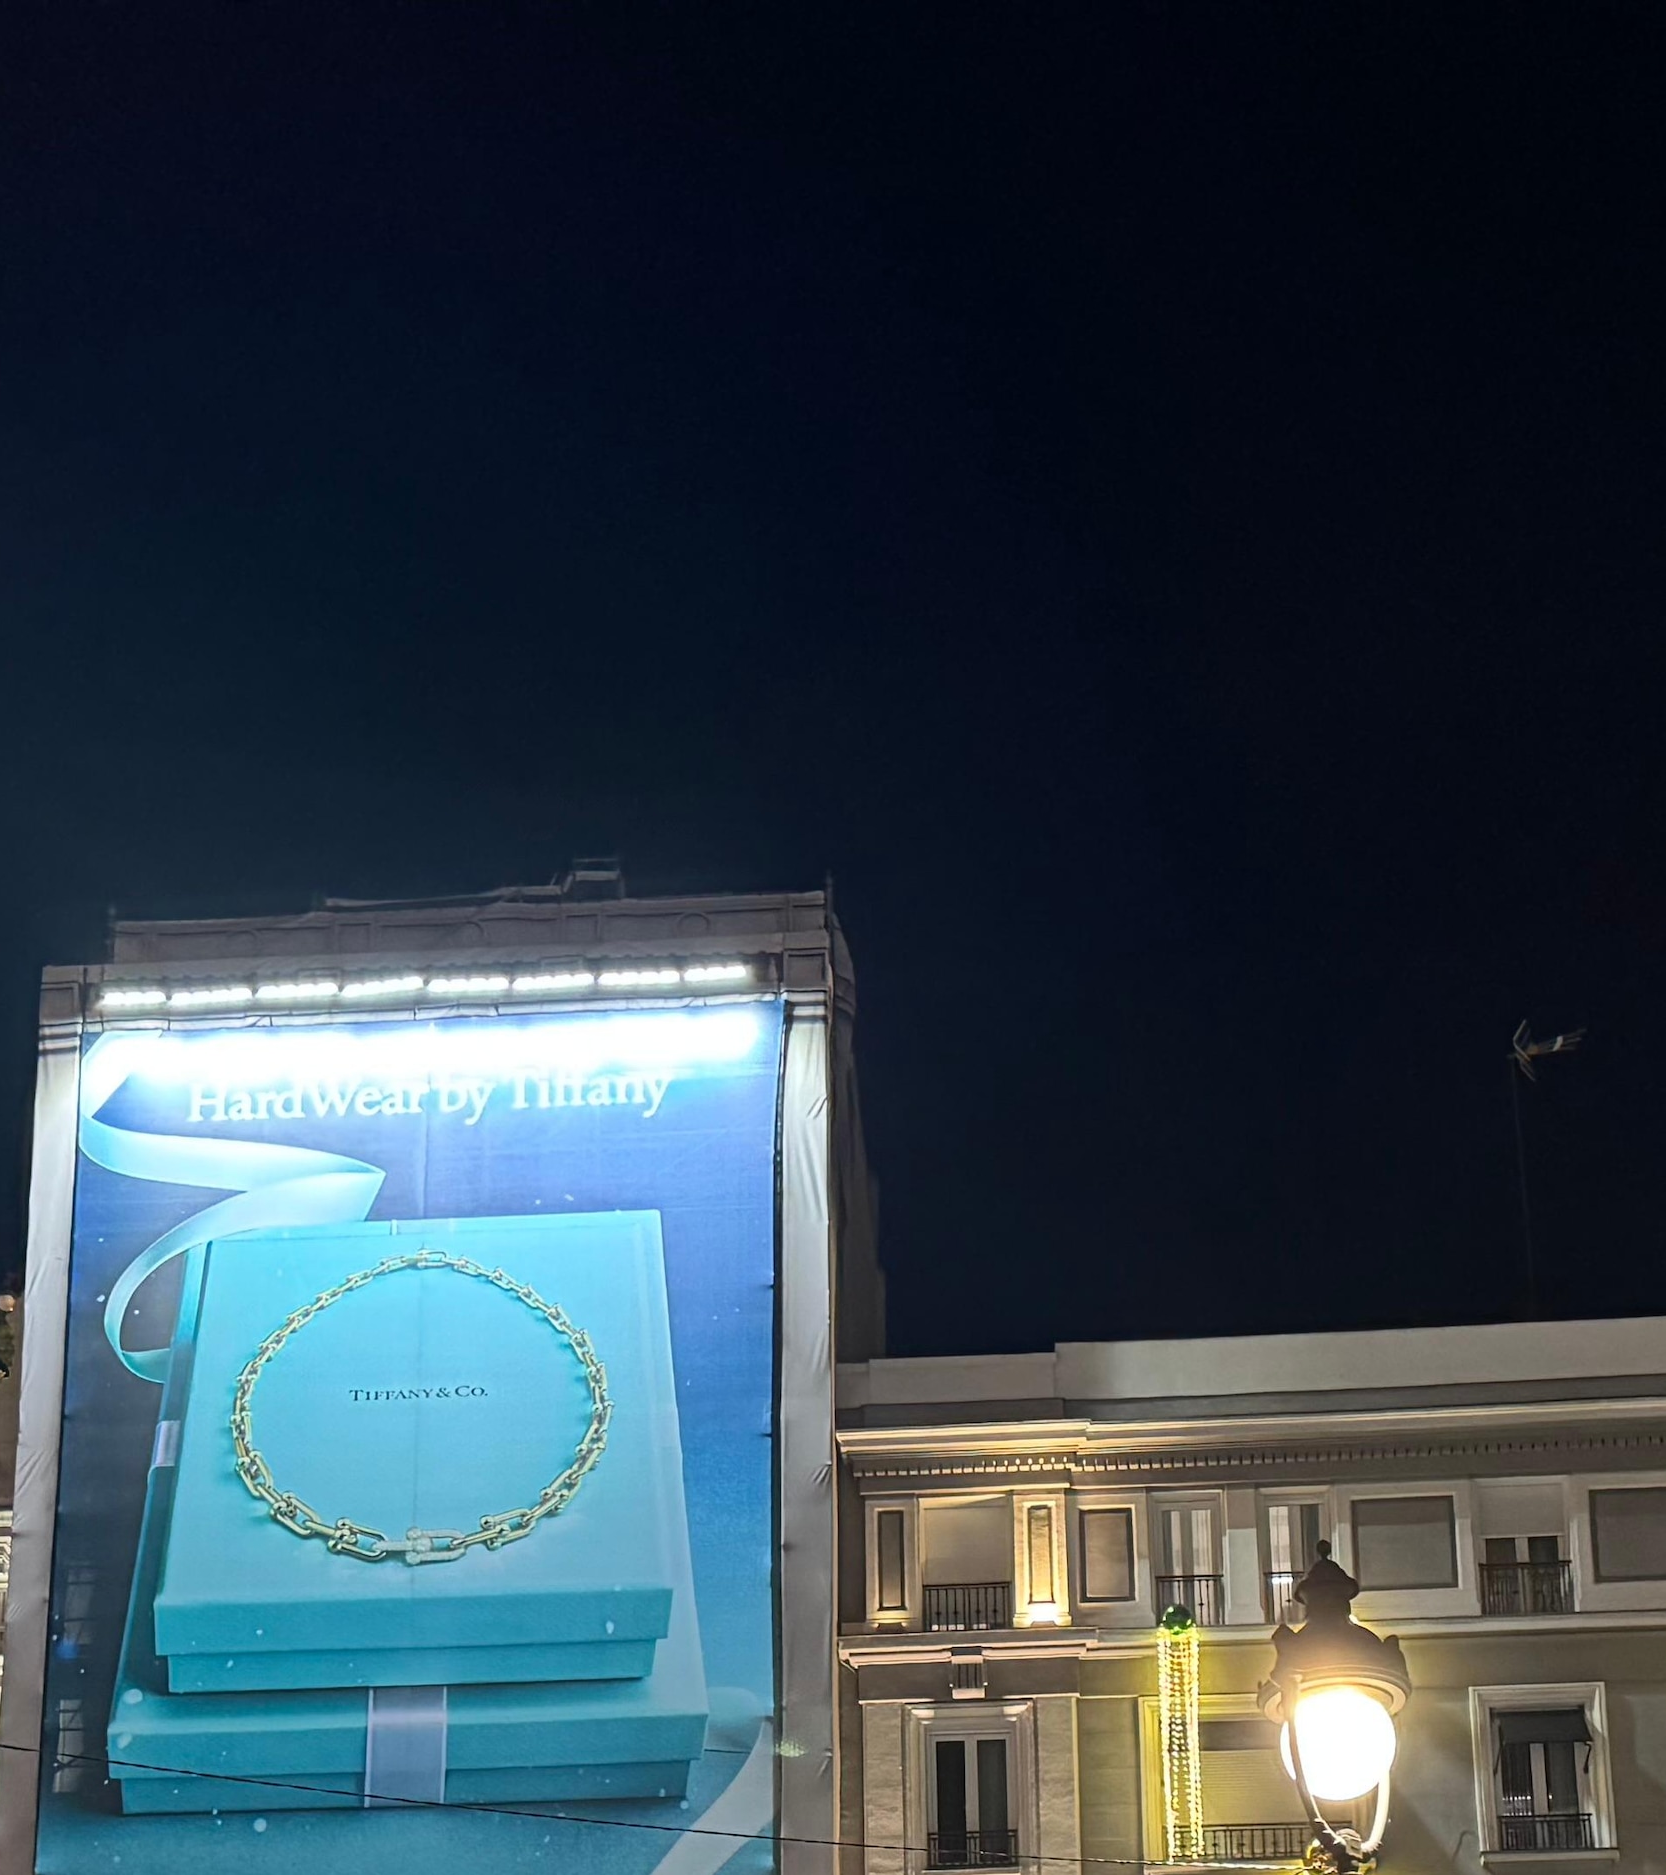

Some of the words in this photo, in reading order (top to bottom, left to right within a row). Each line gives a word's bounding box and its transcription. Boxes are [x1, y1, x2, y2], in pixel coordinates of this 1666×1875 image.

[186, 1076, 432, 1123] HardWear
[439, 1072, 496, 1125] by
[511, 1067, 674, 1118] Tiffany
